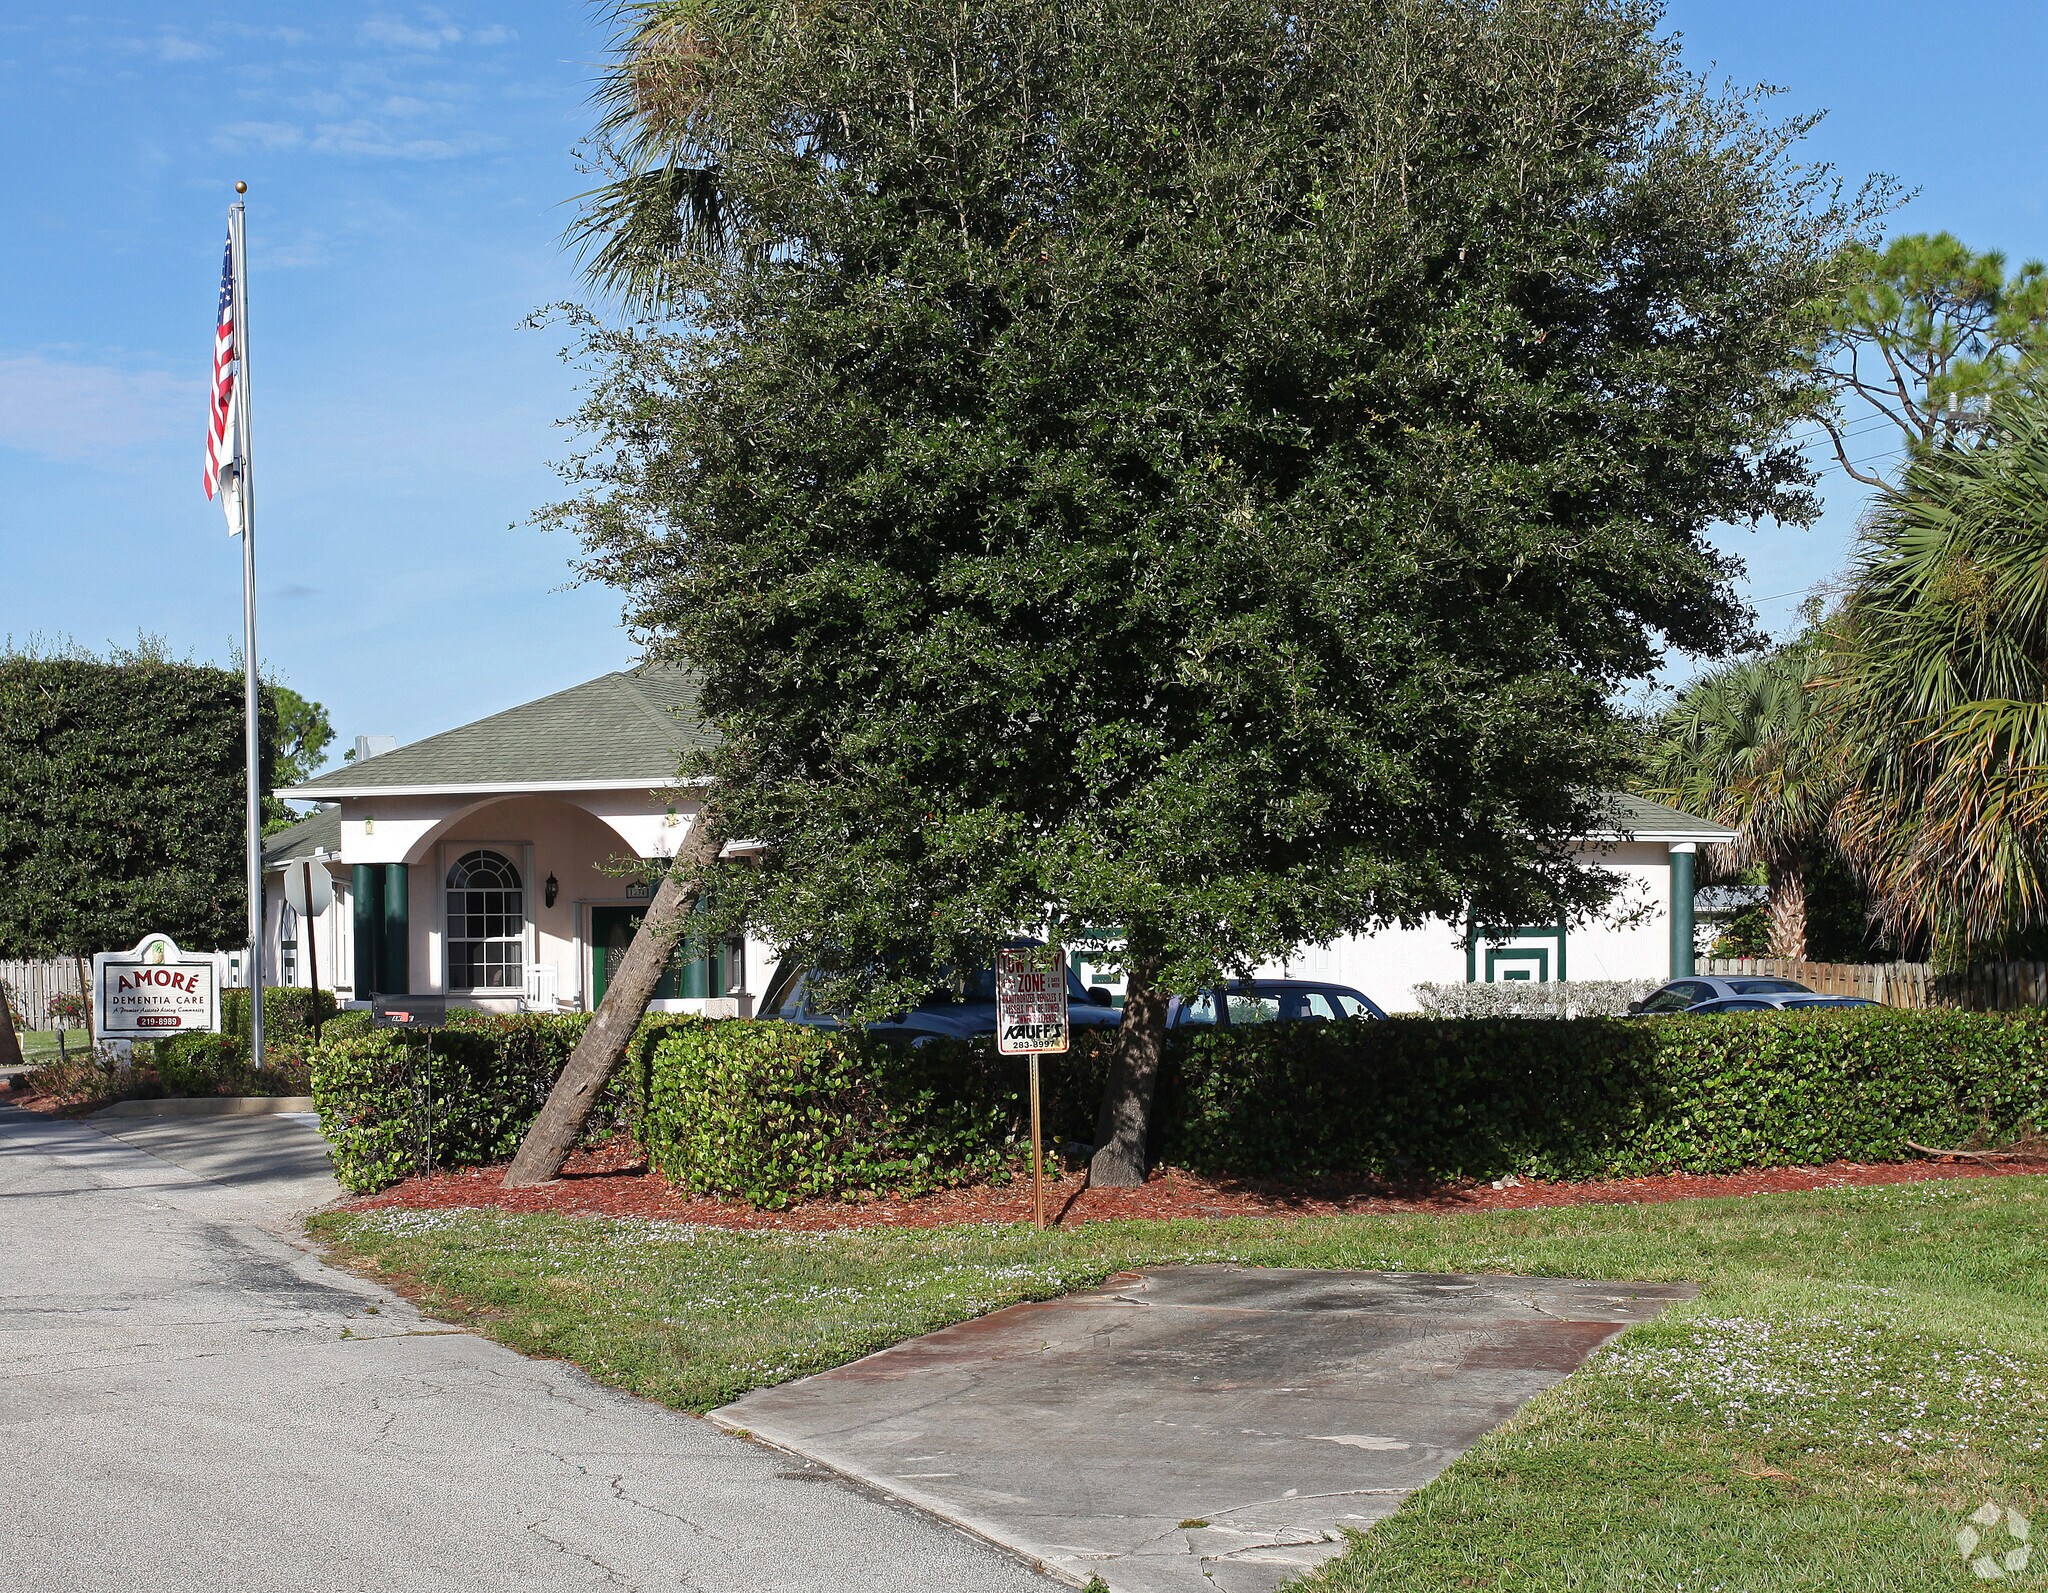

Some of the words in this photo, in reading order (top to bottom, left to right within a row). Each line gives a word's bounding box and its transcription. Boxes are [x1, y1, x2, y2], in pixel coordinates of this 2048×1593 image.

[118, 969, 200, 994] AMORÉ
[1018, 974, 1046, 993] ZONE
[113, 996, 170, 1004] DEMENTIA
[176, 996, 204, 1004] CARE
[1002, 994, 1034, 1003] UNAUTHORIZED
[1038, 993, 1056, 1003] VEHICLES
[1006, 1004, 1023, 1014] VESSELS
[1038, 1004, 1044, 1013] BE
[1046, 1003, 1059, 1012] TOWED
[141, 1017, 177, 1026] 219-8989
[1038, 1014, 1057, 1023] EXPENSE
[1003, 1024, 1063, 1040] KAUFF'S
[1013, 1040, 1055, 1049] 283-8997
